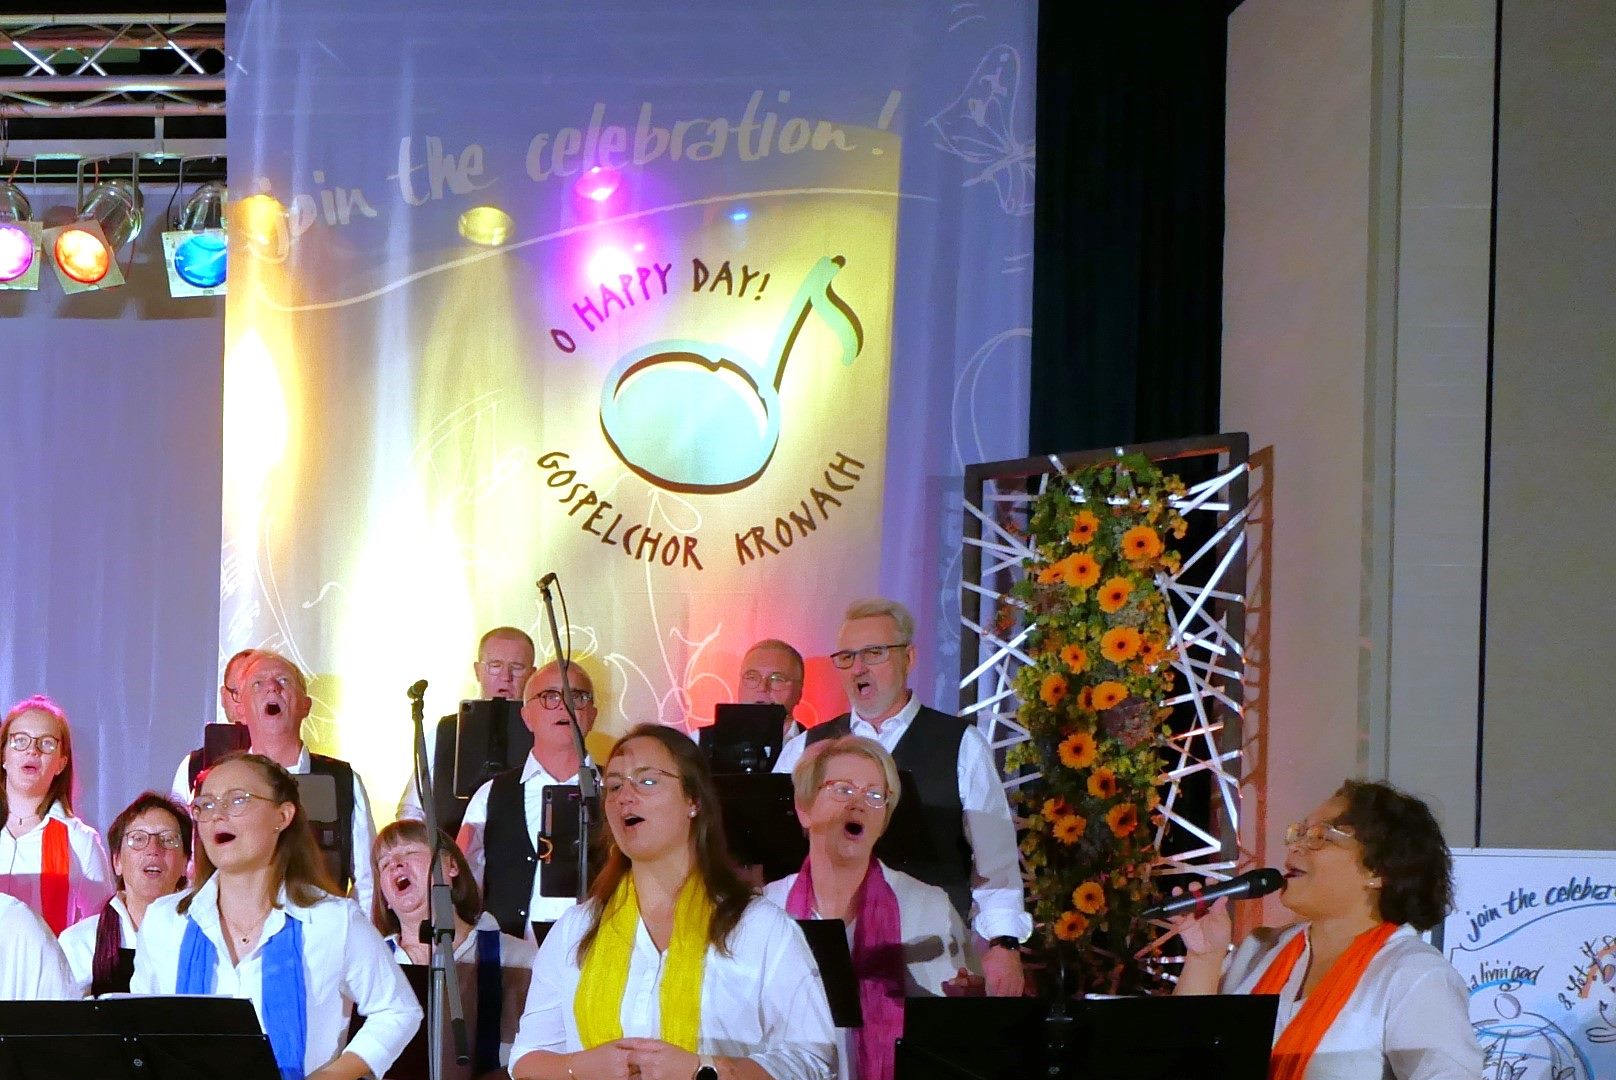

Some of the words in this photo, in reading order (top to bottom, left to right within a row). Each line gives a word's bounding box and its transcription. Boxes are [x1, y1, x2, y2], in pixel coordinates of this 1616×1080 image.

[248, 169, 378, 265] join
[388, 137, 500, 204] the
[549, 328, 577, 354] O
[572, 261, 674, 333] HAPPY
[691, 258, 772, 303] DAY!
[537, 449, 704, 571] GOSPELCHOR
[734, 449, 866, 566] KRONACH
[1466, 904, 1502, 943] join
[1501, 887, 1541, 915] the
[1545, 876, 1616, 905] celebra
